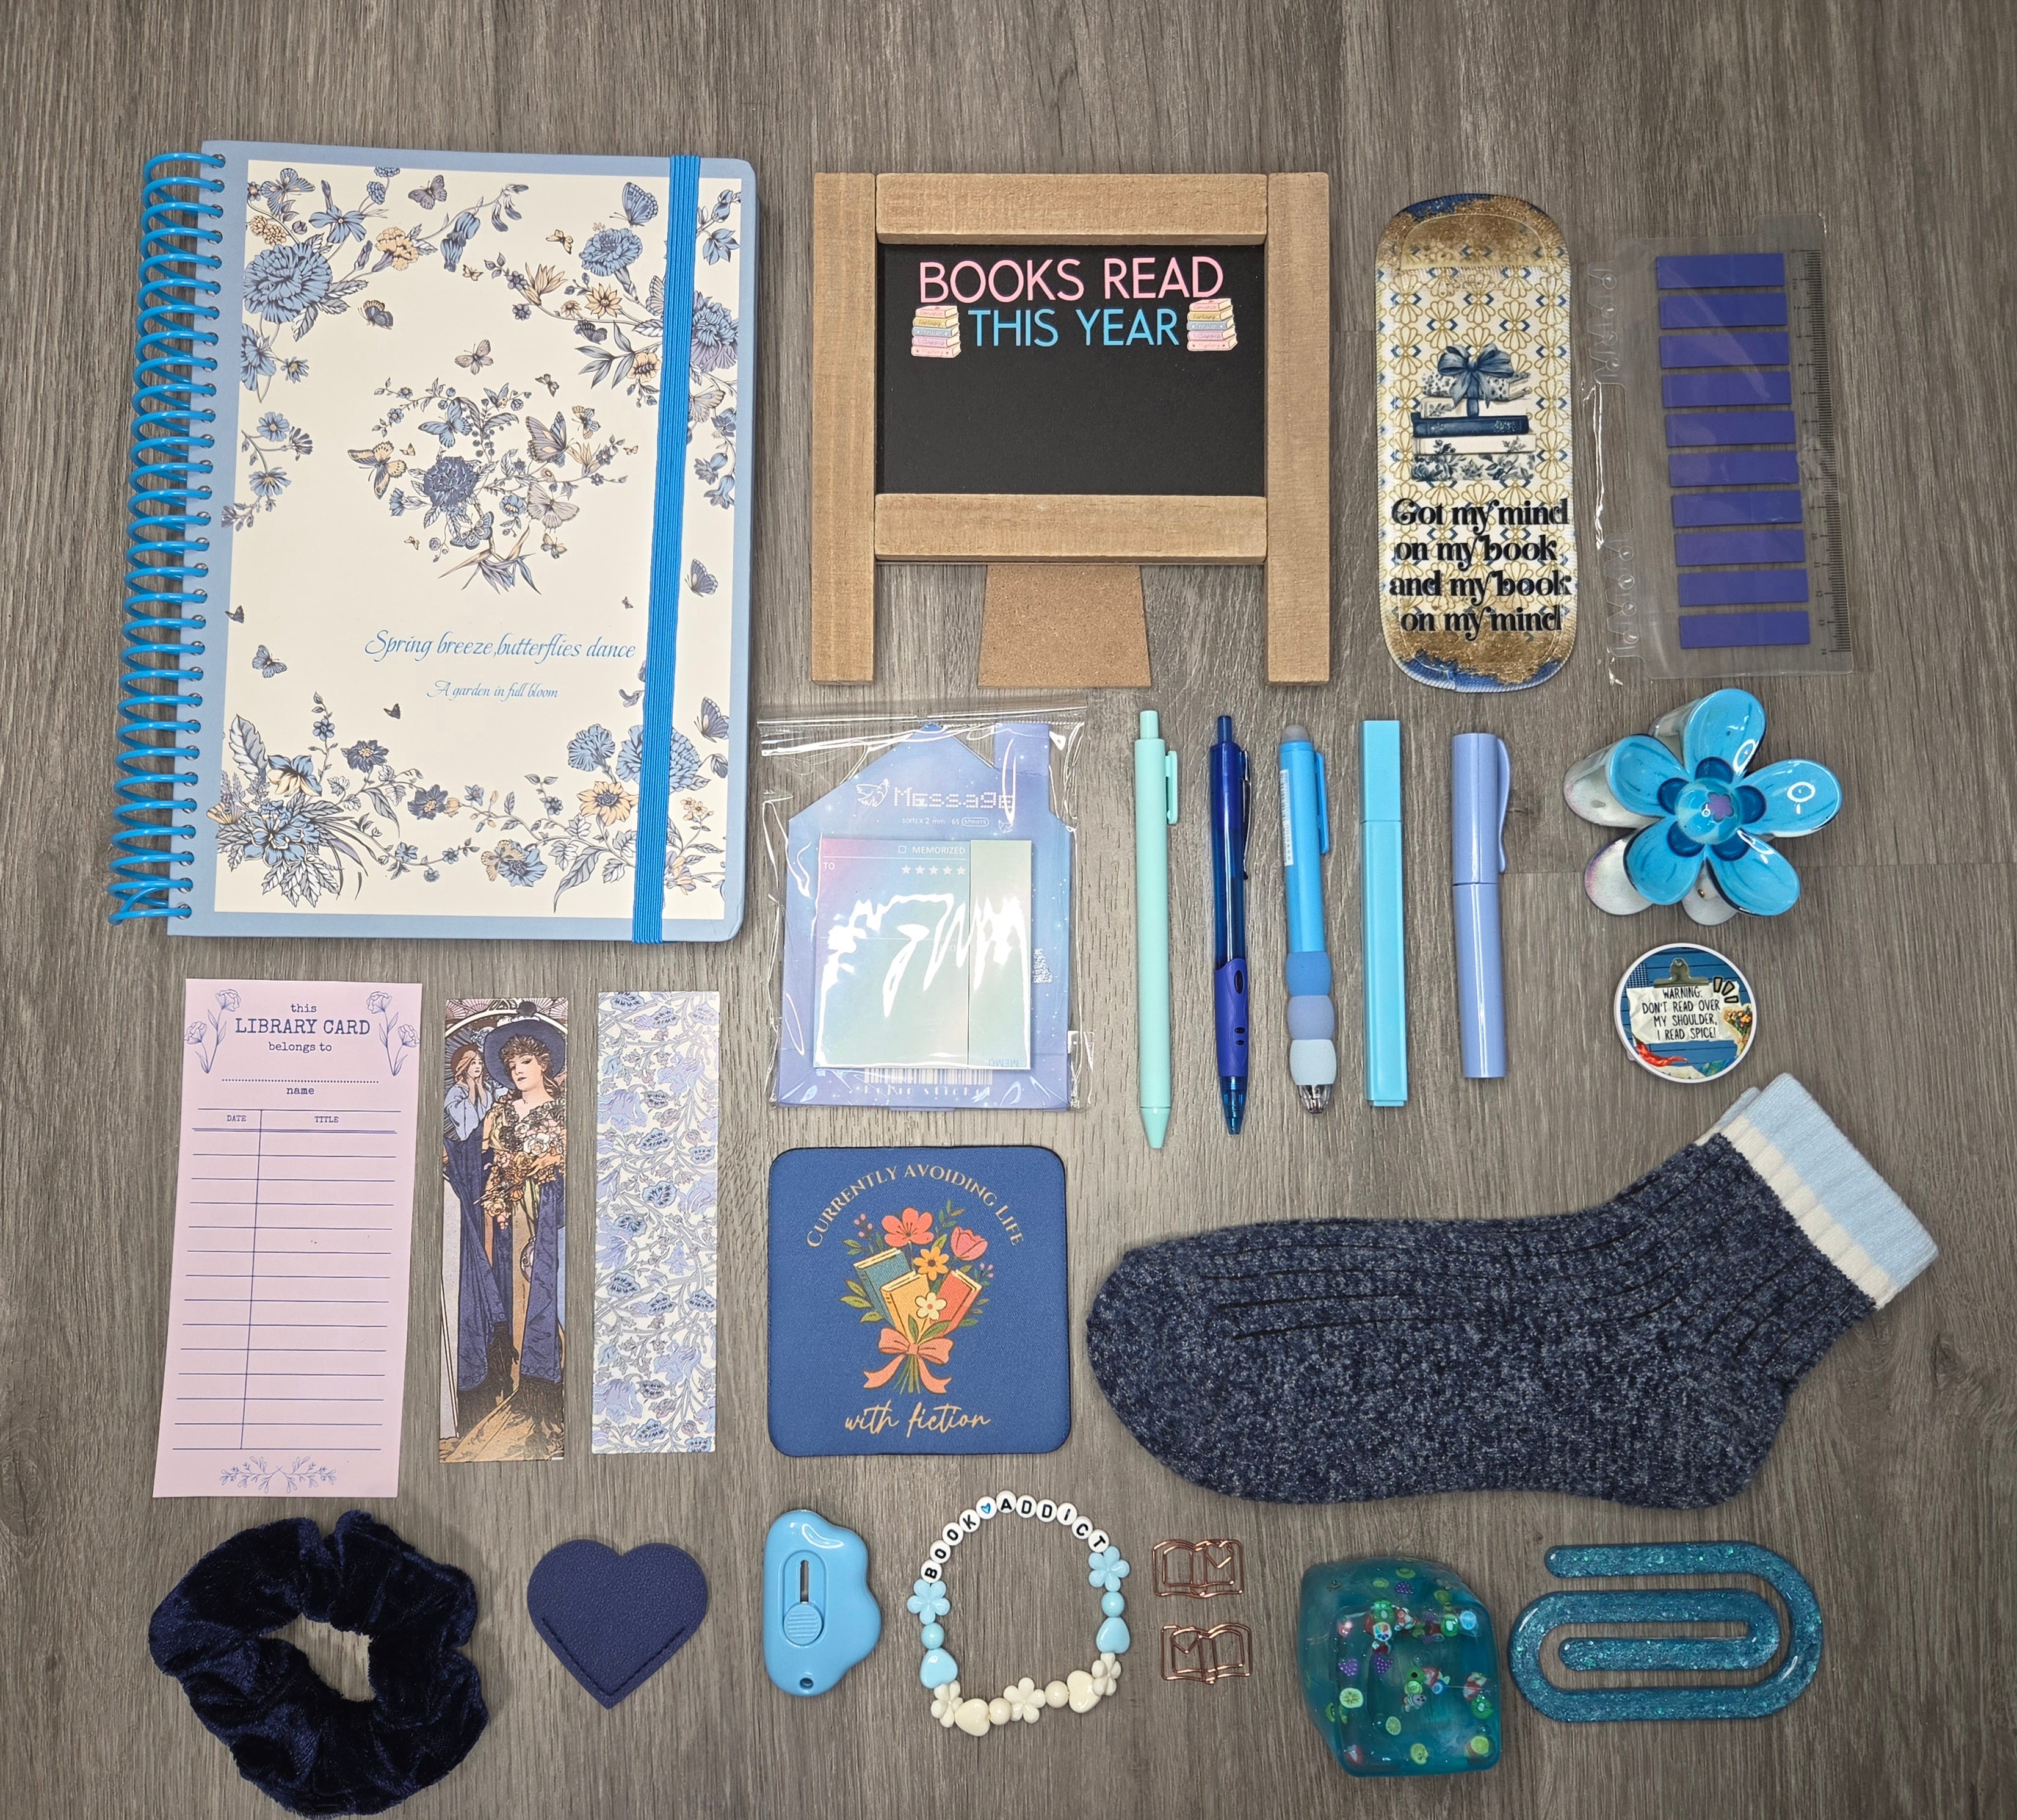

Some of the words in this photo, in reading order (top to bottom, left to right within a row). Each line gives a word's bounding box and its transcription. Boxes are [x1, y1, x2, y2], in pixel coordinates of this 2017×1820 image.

[920, 258, 1084, 303] BOOKS
[1104, 256, 1223, 299] READ
[968, 308, 1059, 347] THIS
[1076, 308, 1179, 346] YEAR
[1391, 498, 1444, 525] Got
[1452, 499, 1499, 535] my
[1498, 498, 1570, 525] mind
[1394, 541, 1429, 561] on
[1437, 535, 1485, 572] my
[1483, 534, 1557, 562] book
[1389, 570, 1443, 596] and
[1450, 571, 1497, 607] my
[1496, 569, 1572, 597] book
[1401, 612, 1435, 632] on
[1443, 607, 1491, 641] my
[1490, 604, 1562, 632] mind
[364, 629, 433, 662] Spring
[586, 636, 636, 658] dance
[427, 679, 449, 698] A
[452, 686, 490, 701] garden
[494, 685, 504, 698] in
[501, 682, 527, 702] full
[527, 682, 559, 698] bloom
[894, 787, 1016, 809] Message
[913, 845, 966, 854] MEMORIZED
[1662, 986, 1703, 1000] WARNING:
[291, 1003, 317, 1013] this
[1642, 1002, 1668, 1014] DON'T
[1673, 1000, 1693, 1013] READ
[1698, 999, 1720, 1011] OVER
[235, 1017, 317, 1034] LIBRARY
[323, 1019, 371, 1035] CARD
[1654, 1015, 1667, 1027] MY
[1673, 1013, 1717, 1027] SHOULDER,
[1657, 1030, 1661, 1041] I
[1665, 1028, 1685, 1041] READ
[1690, 1027, 1717, 1039] SPICE!
[269, 1041, 316, 1053] belongs
[319, 1043, 332, 1052] to
[286, 1086, 315, 1096] name
[806, 1166, 897, 1248] CURRENTLY
[904, 1164, 998, 1208] AVOIDING
[994, 1205, 1024, 1246] LIFE
[845, 1399, 899, 1435] with
[906, 1401, 991, 1438] fiction
[924, 1514, 976, 1579] BOOK
[1001, 1498, 1106, 1548] ADDICT
